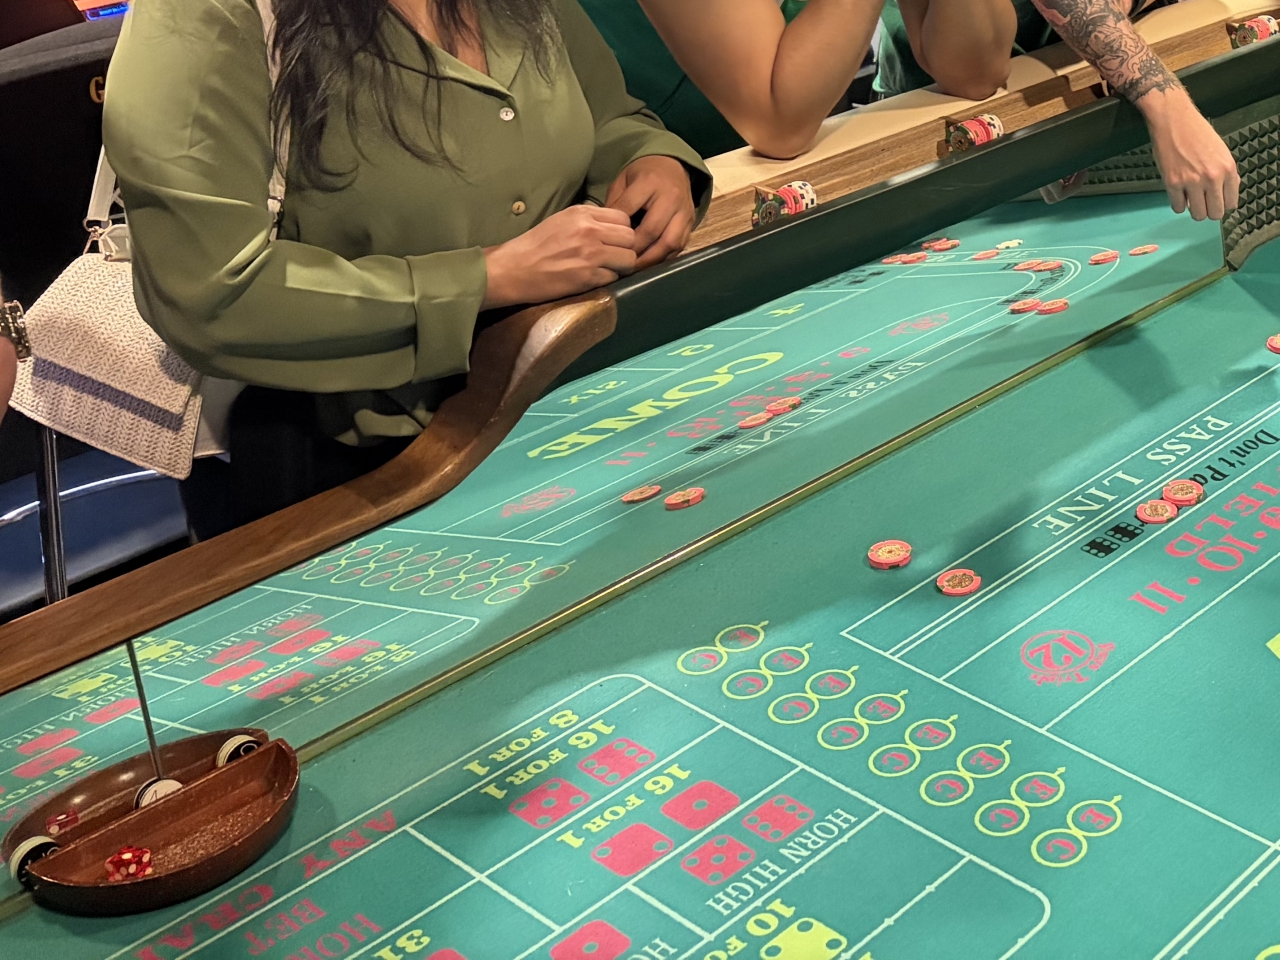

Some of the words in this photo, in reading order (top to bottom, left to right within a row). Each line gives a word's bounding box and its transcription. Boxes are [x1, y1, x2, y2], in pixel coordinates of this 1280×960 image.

[1147, 414, 1233, 467] PASS
[1032, 468, 1145, 536] LINE
[1028, 635, 1087, 670] 12
[549, 709, 579, 729] 8
[568, 720, 615, 750] 16
[488, 726, 549, 762] FOR
[463, 759, 490, 777] 1
[507, 746, 568, 785] FOR
[643, 763, 692, 796] 16
[480, 783, 508, 800] 1
[583, 789, 644, 829] FOR
[299, 809, 397, 880] ANY
[557, 828, 585, 850] 1
[778, 808, 859, 864] HORN
[705, 858, 788, 917] HIGH
[244, 898, 327, 957] BET
[745, 898, 797, 936] 10
